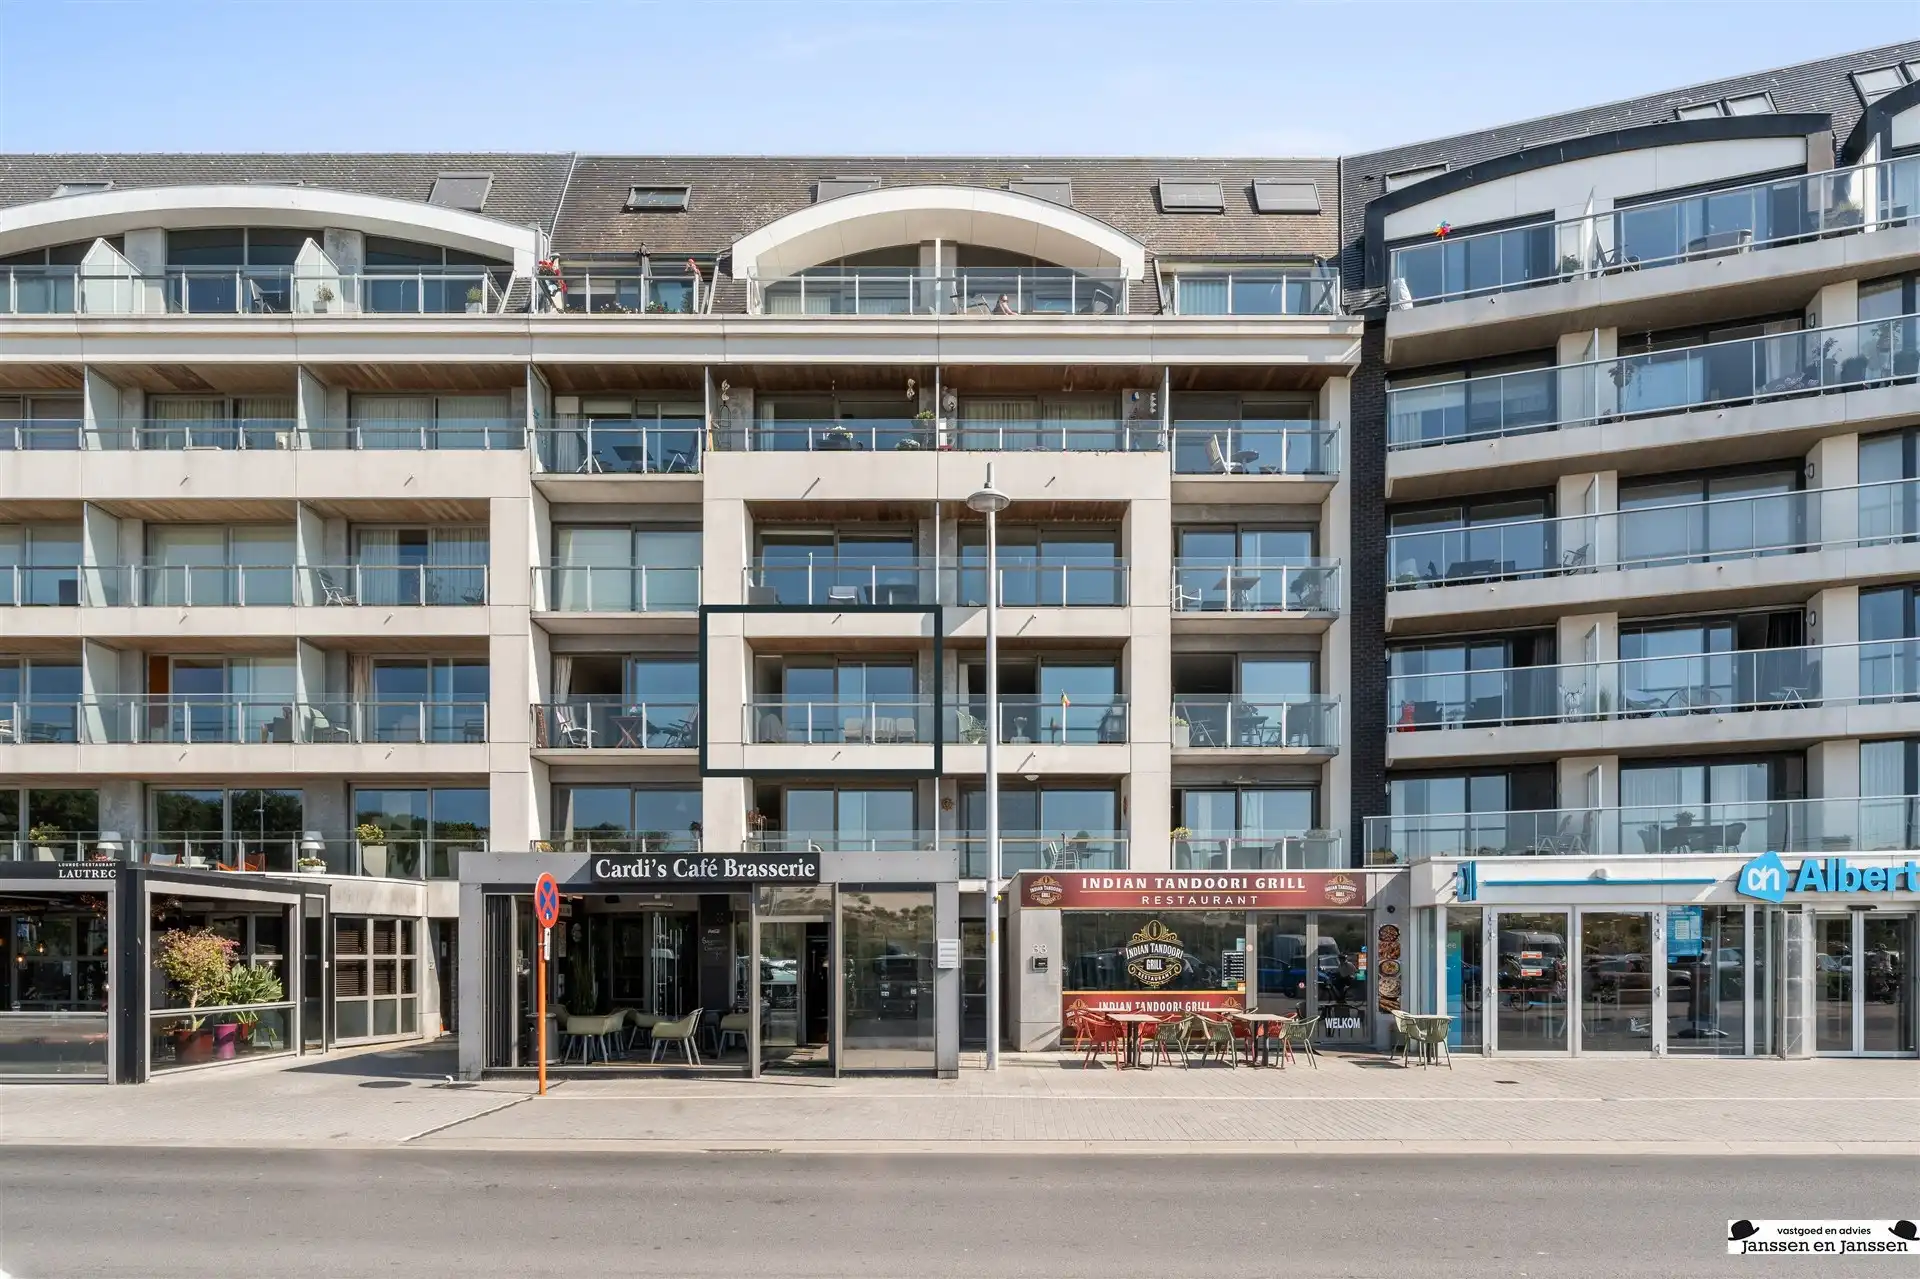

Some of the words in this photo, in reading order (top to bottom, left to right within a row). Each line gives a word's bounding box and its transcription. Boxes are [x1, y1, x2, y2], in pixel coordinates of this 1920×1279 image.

[58, 869, 117, 879] LAUTREC
[595, 858, 667, 878] Cardi's
[673, 858, 718, 878] Café
[724, 858, 816, 878] Brasserie
[1794, 858, 1920, 893] Albert
[1082, 877, 1147, 889] INDIAN
[1155, 877, 1248, 889] TANDOORI
[1255, 877, 1306, 889] GRILL
[1141, 895, 1258, 905] RESTAURANT
[1032, 944, 1048, 954] 33
[1125, 944, 1149, 960] INDIAN
[1149, 943, 1184, 960] TANDOORI
[1146, 959, 1163, 970] GRILL
[1325, 1017, 1361, 1029] WELKOM
